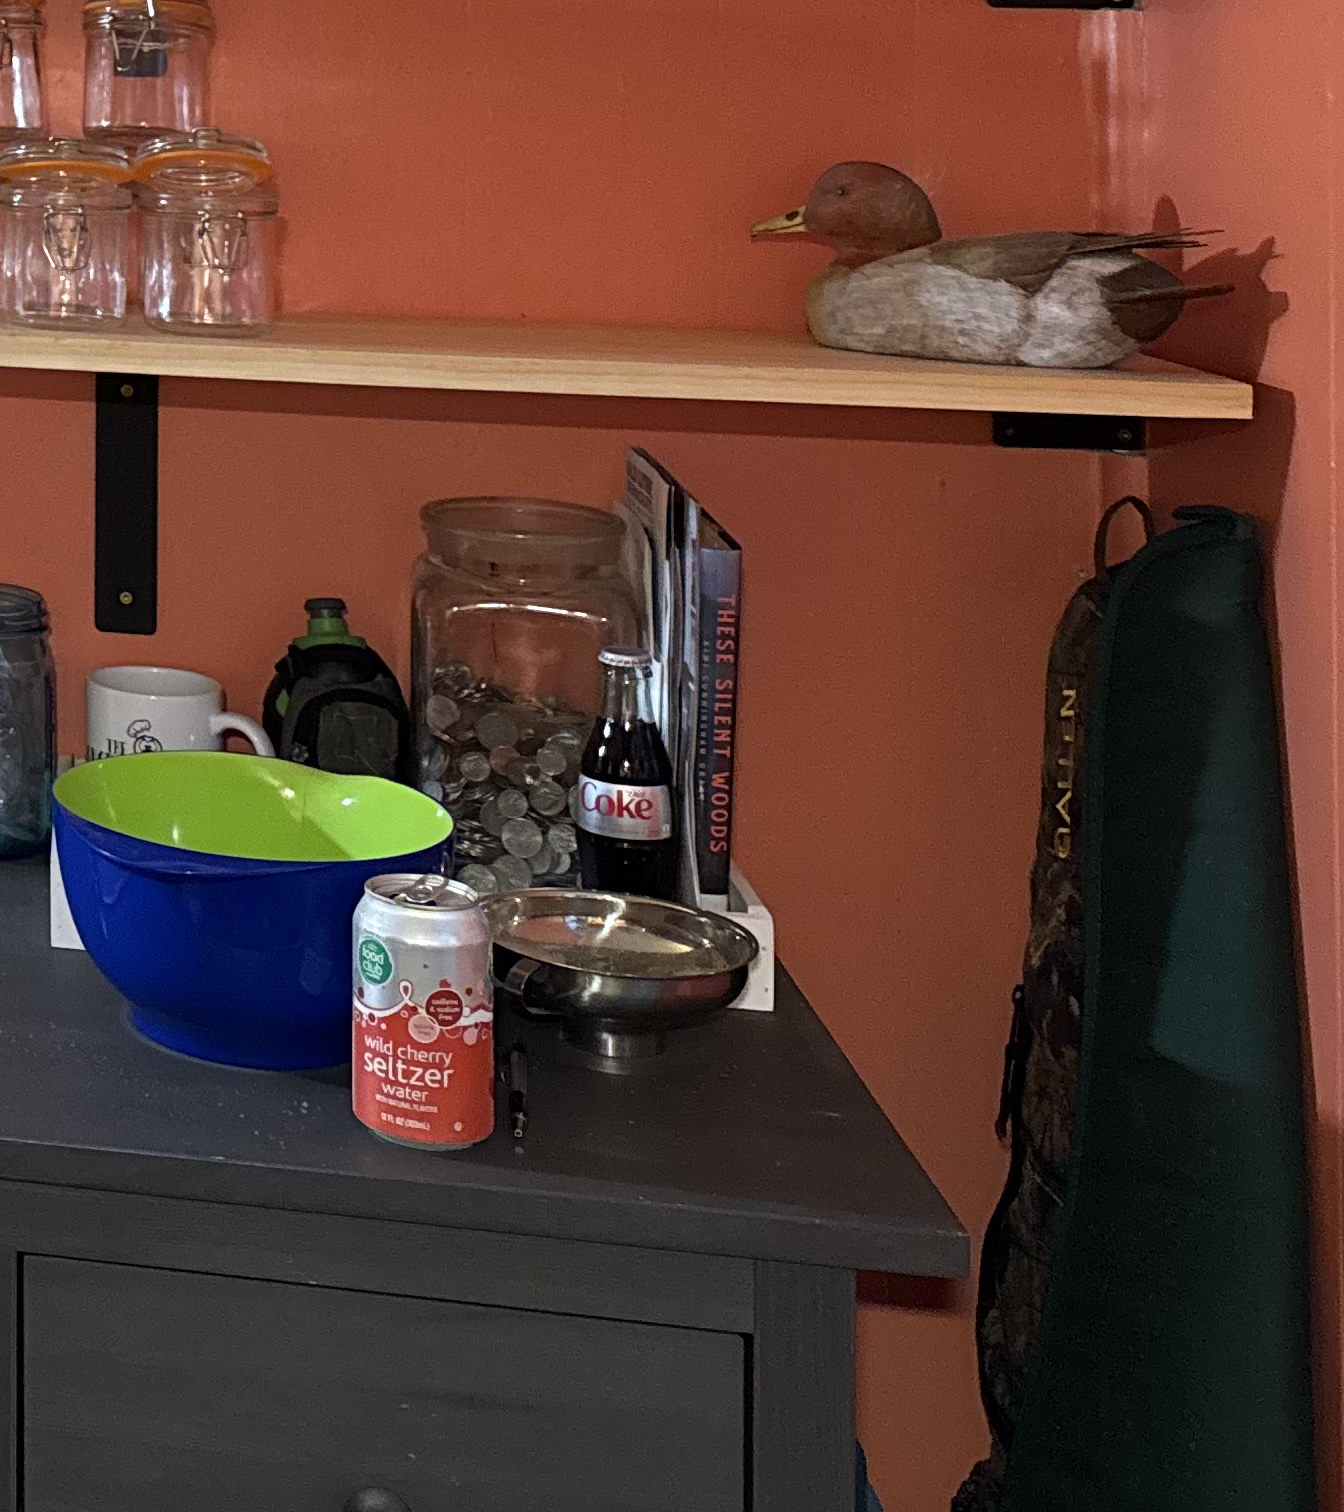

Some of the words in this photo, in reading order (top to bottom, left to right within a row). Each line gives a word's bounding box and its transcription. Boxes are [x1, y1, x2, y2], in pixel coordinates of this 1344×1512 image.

[715, 593, 737, 665] THESE
[712, 678, 734, 759] SILENT
[580, 781, 654, 820] Coke
[709, 771, 731, 854] WOODS
[362, 944, 385, 965] food
[362, 960, 384, 976] club
[364, 1034, 393, 1056] wild
[397, 1043, 453, 1067] cherry
[363, 1052, 455, 1088] seltzer
[381, 1081, 430, 1103] water
